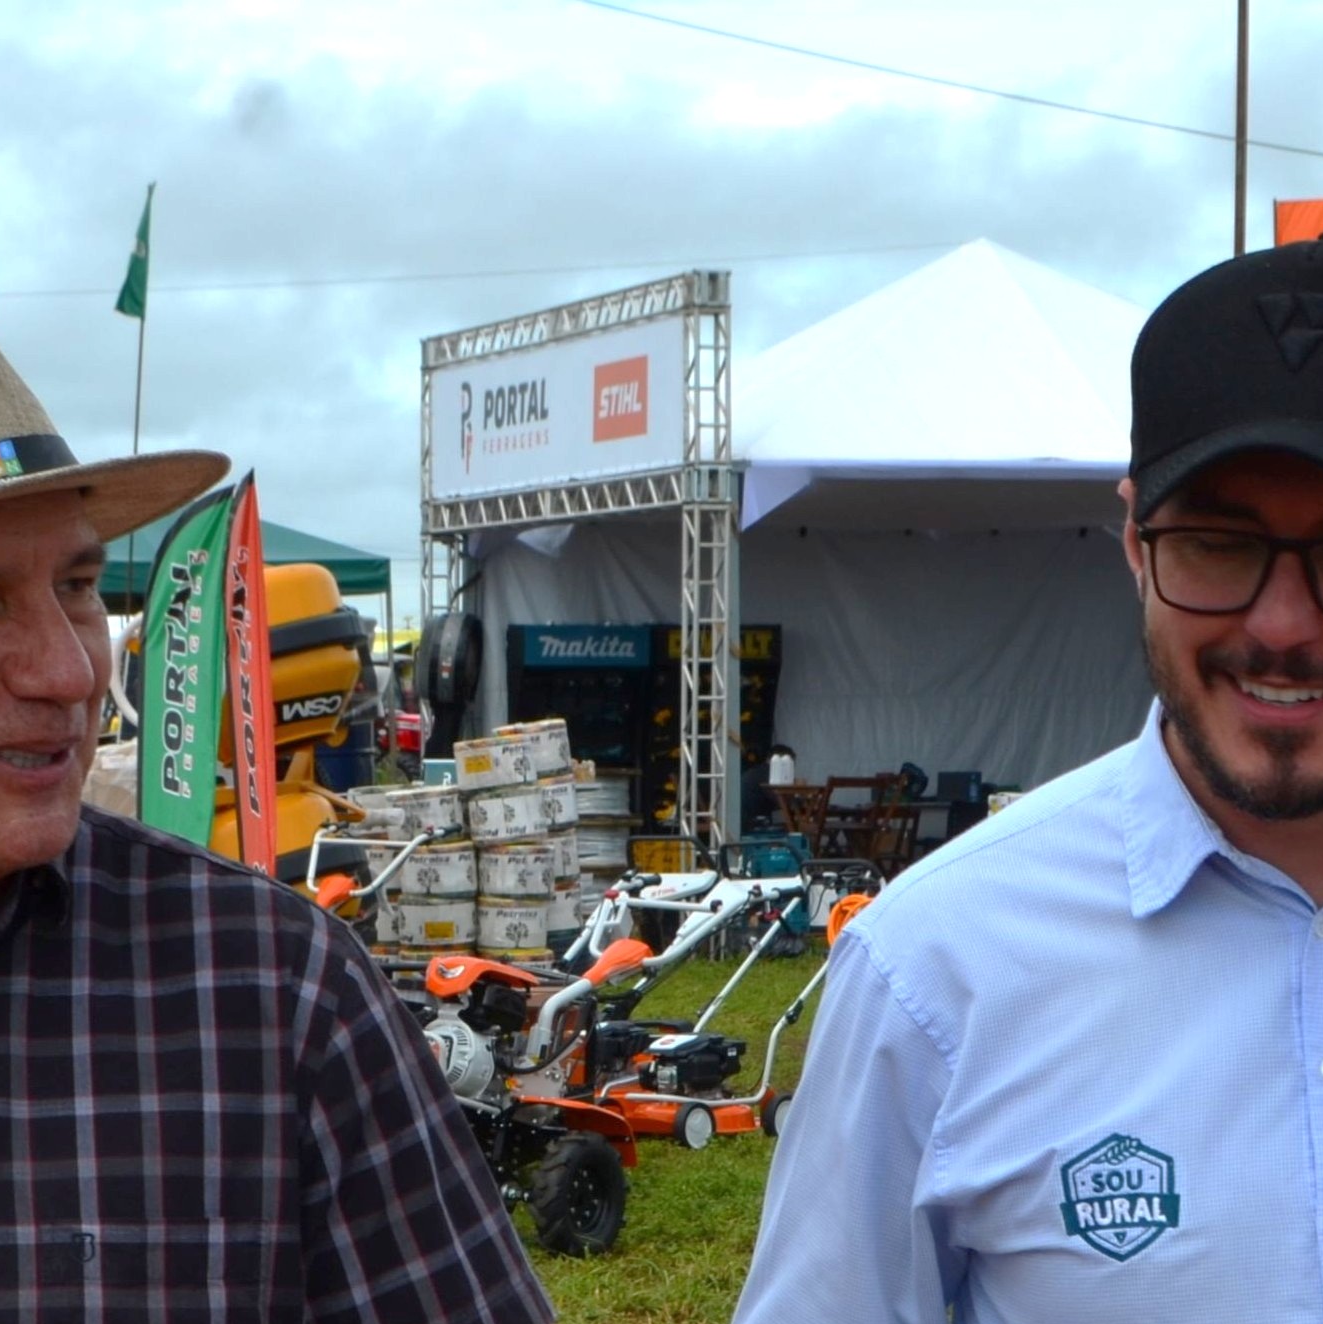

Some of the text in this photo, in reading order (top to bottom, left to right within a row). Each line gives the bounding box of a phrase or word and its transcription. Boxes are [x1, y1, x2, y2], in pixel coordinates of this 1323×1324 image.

[483, 377, 549, 430] PORTAL
[599, 381, 643, 419] STIHL
[482, 430, 550, 455] FERRAGENS
[538, 635, 636, 658] makita
[162, 561, 196, 797] PORTAL
[282, 694, 343, 722] CSM
[1091, 1169, 1144, 1193] SOU
[1075, 1196, 1168, 1229] RURAL
